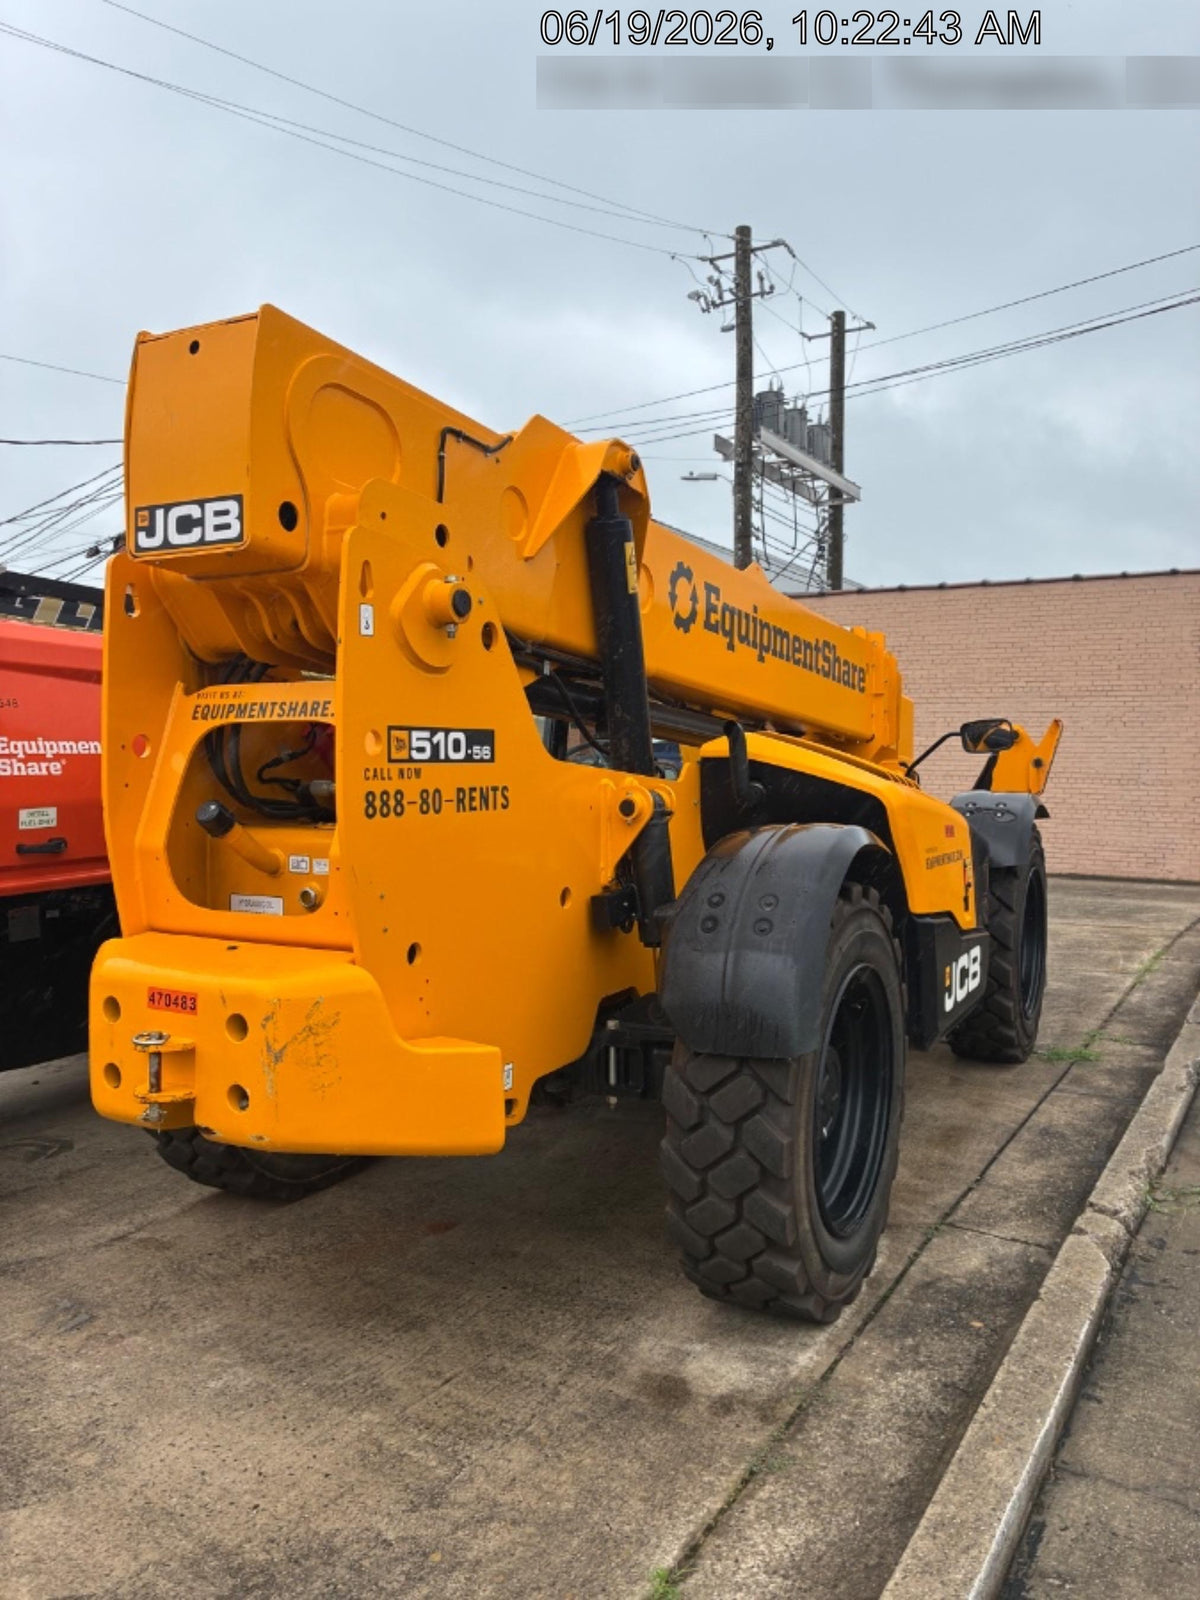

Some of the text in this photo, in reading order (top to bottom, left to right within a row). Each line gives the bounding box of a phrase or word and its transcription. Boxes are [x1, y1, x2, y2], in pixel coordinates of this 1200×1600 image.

[137, 499, 241, 549] JCB
[703, 581, 867, 694] EquipmentShare
[0, 737, 102, 758] Equipmen
[363, 767, 422, 781] CALL NOW
[364, 785, 510, 820] 888-80-RENTS
[944, 945, 981, 1012] JCB
[148, 991, 197, 1011] 470483
